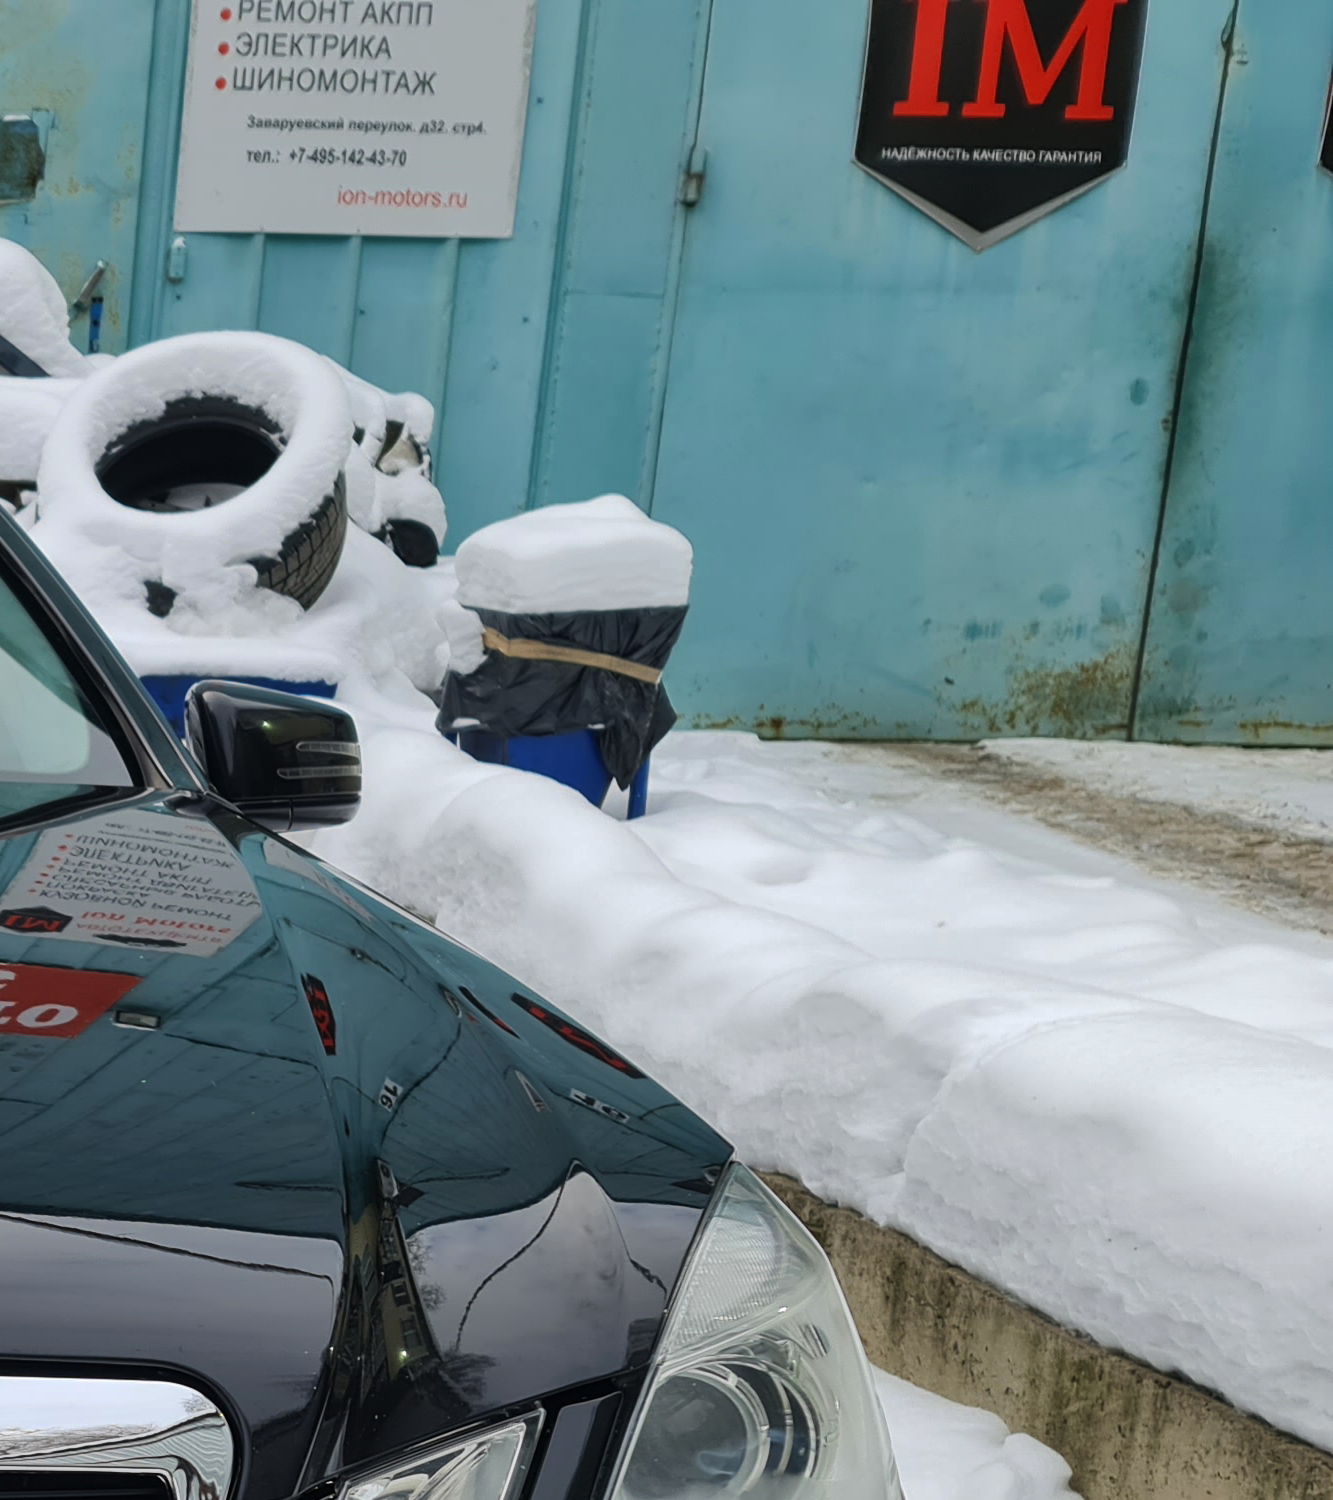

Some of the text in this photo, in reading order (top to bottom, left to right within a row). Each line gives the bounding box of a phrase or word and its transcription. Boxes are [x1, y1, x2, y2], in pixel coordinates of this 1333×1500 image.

[238, 0, 433, 25] РЕМОНТ АКПП
[235, 32, 392, 60] ЭЛЕКТРИКА
[892, 0, 1129, 121] IM
[233, 66, 437, 96] ШИНОМОНТАЖ
[289, 147, 407, 167] +7-495-142-43-70
[882, 146, 1102, 164] НАДЁЖНОСТЬ КАЧЕСТВО ГАРАНТИЯ
[337, 185, 468, 209] ion-motors.ru
